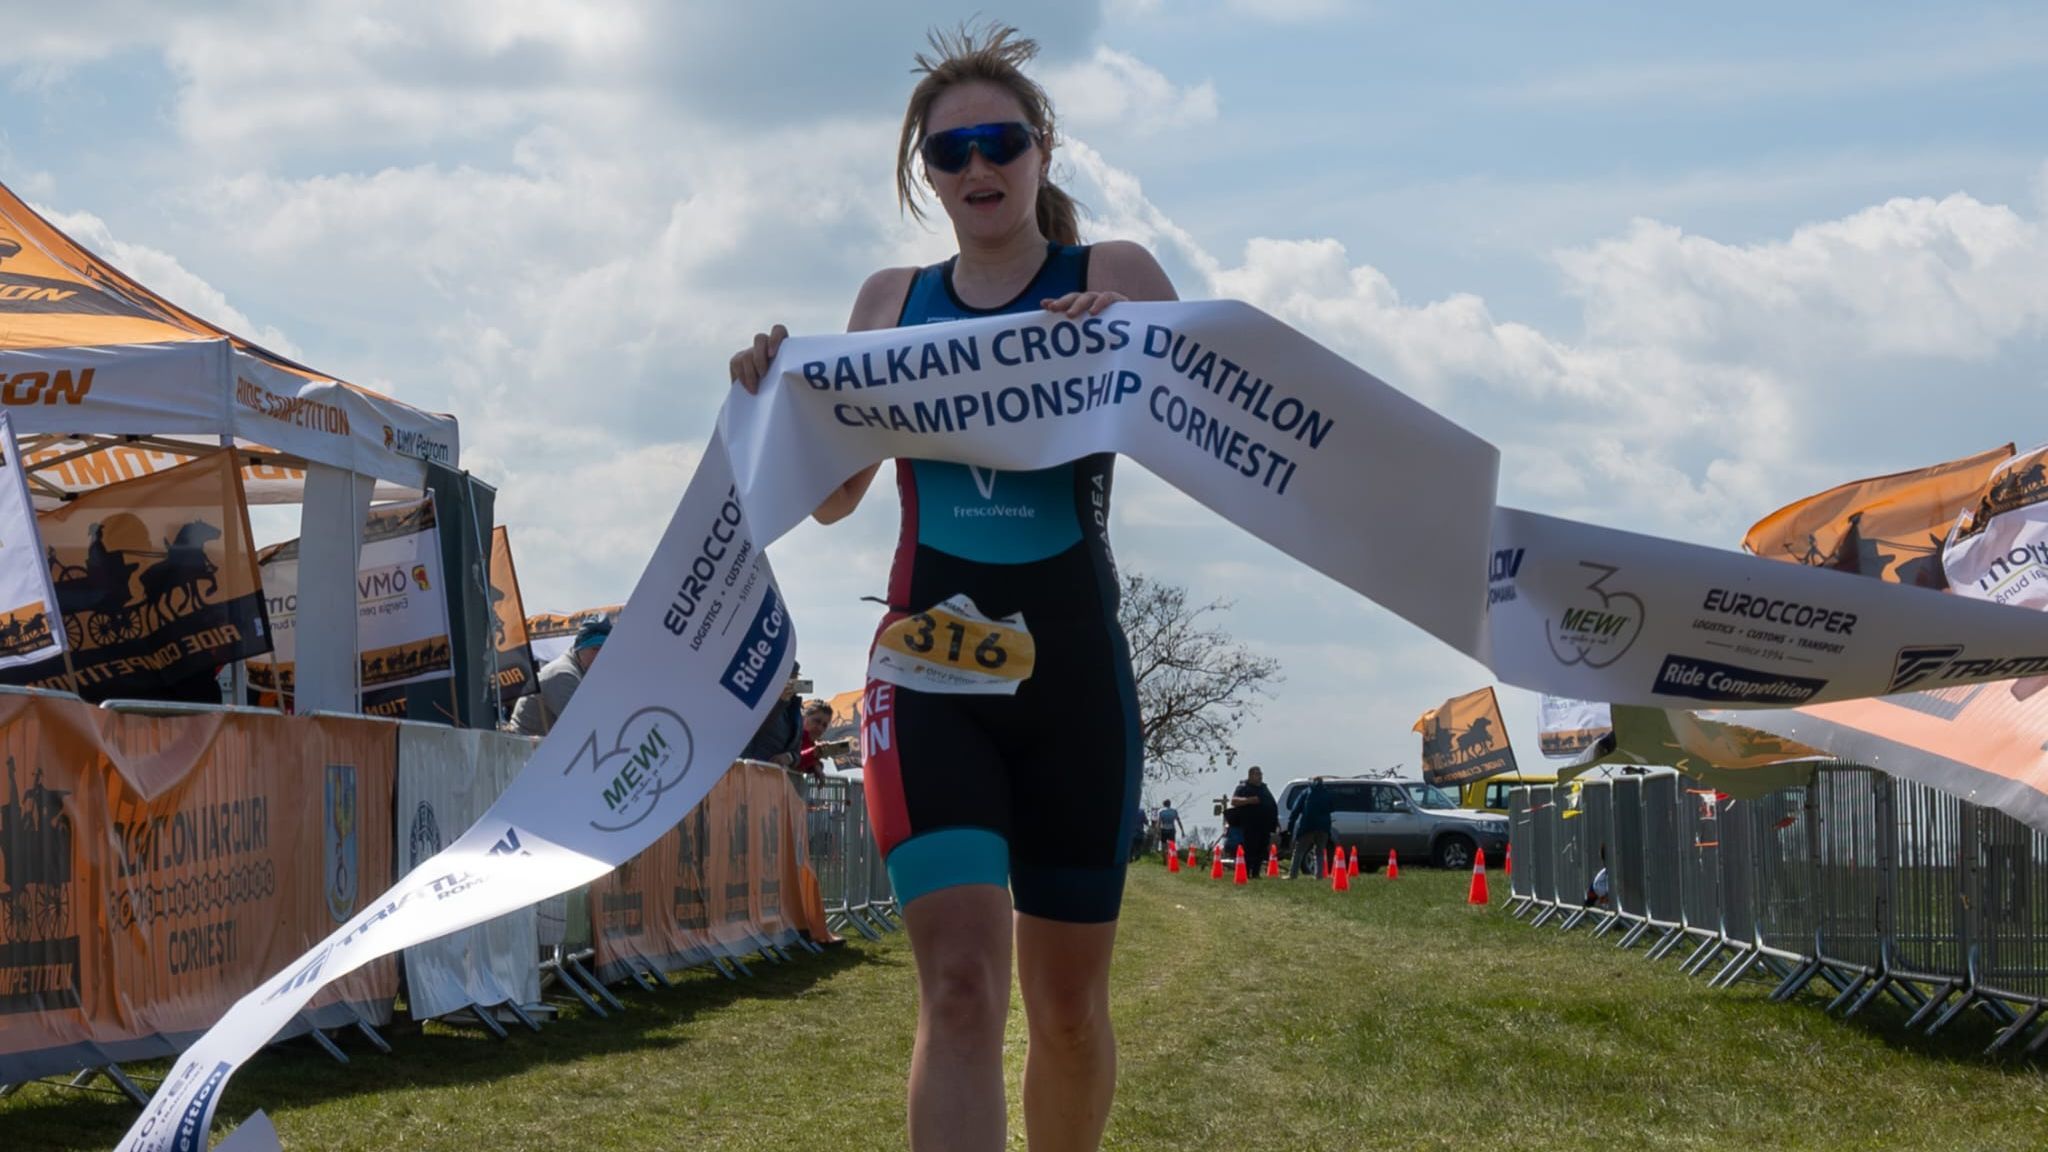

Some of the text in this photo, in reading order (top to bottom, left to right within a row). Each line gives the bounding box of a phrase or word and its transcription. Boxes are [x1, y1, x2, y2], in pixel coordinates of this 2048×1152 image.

[0, 368, 96, 405] ON
[803, 319, 1334, 449] BALKAN CROSS DUATHLON
[834, 370, 1298, 495] CHAMPIONSHIP CORNESTI
[953, 504, 1036, 518] FrescoVerde
[689, 599, 723, 652] LOGISTICS
[1560, 607, 1628, 637] MEWI
[1703, 588, 1858, 636] EUROCCOPER
[904, 613, 1008, 669] 316
[1692, 619, 1846, 655] LOGISTICS CUSTOMS TRANSPORT
[1761, 648, 1785, 661] 1994
[732, 640, 772, 692] Ride
[1664, 663, 1813, 700] Ride Competition
[602, 727, 667, 811] MEWI
